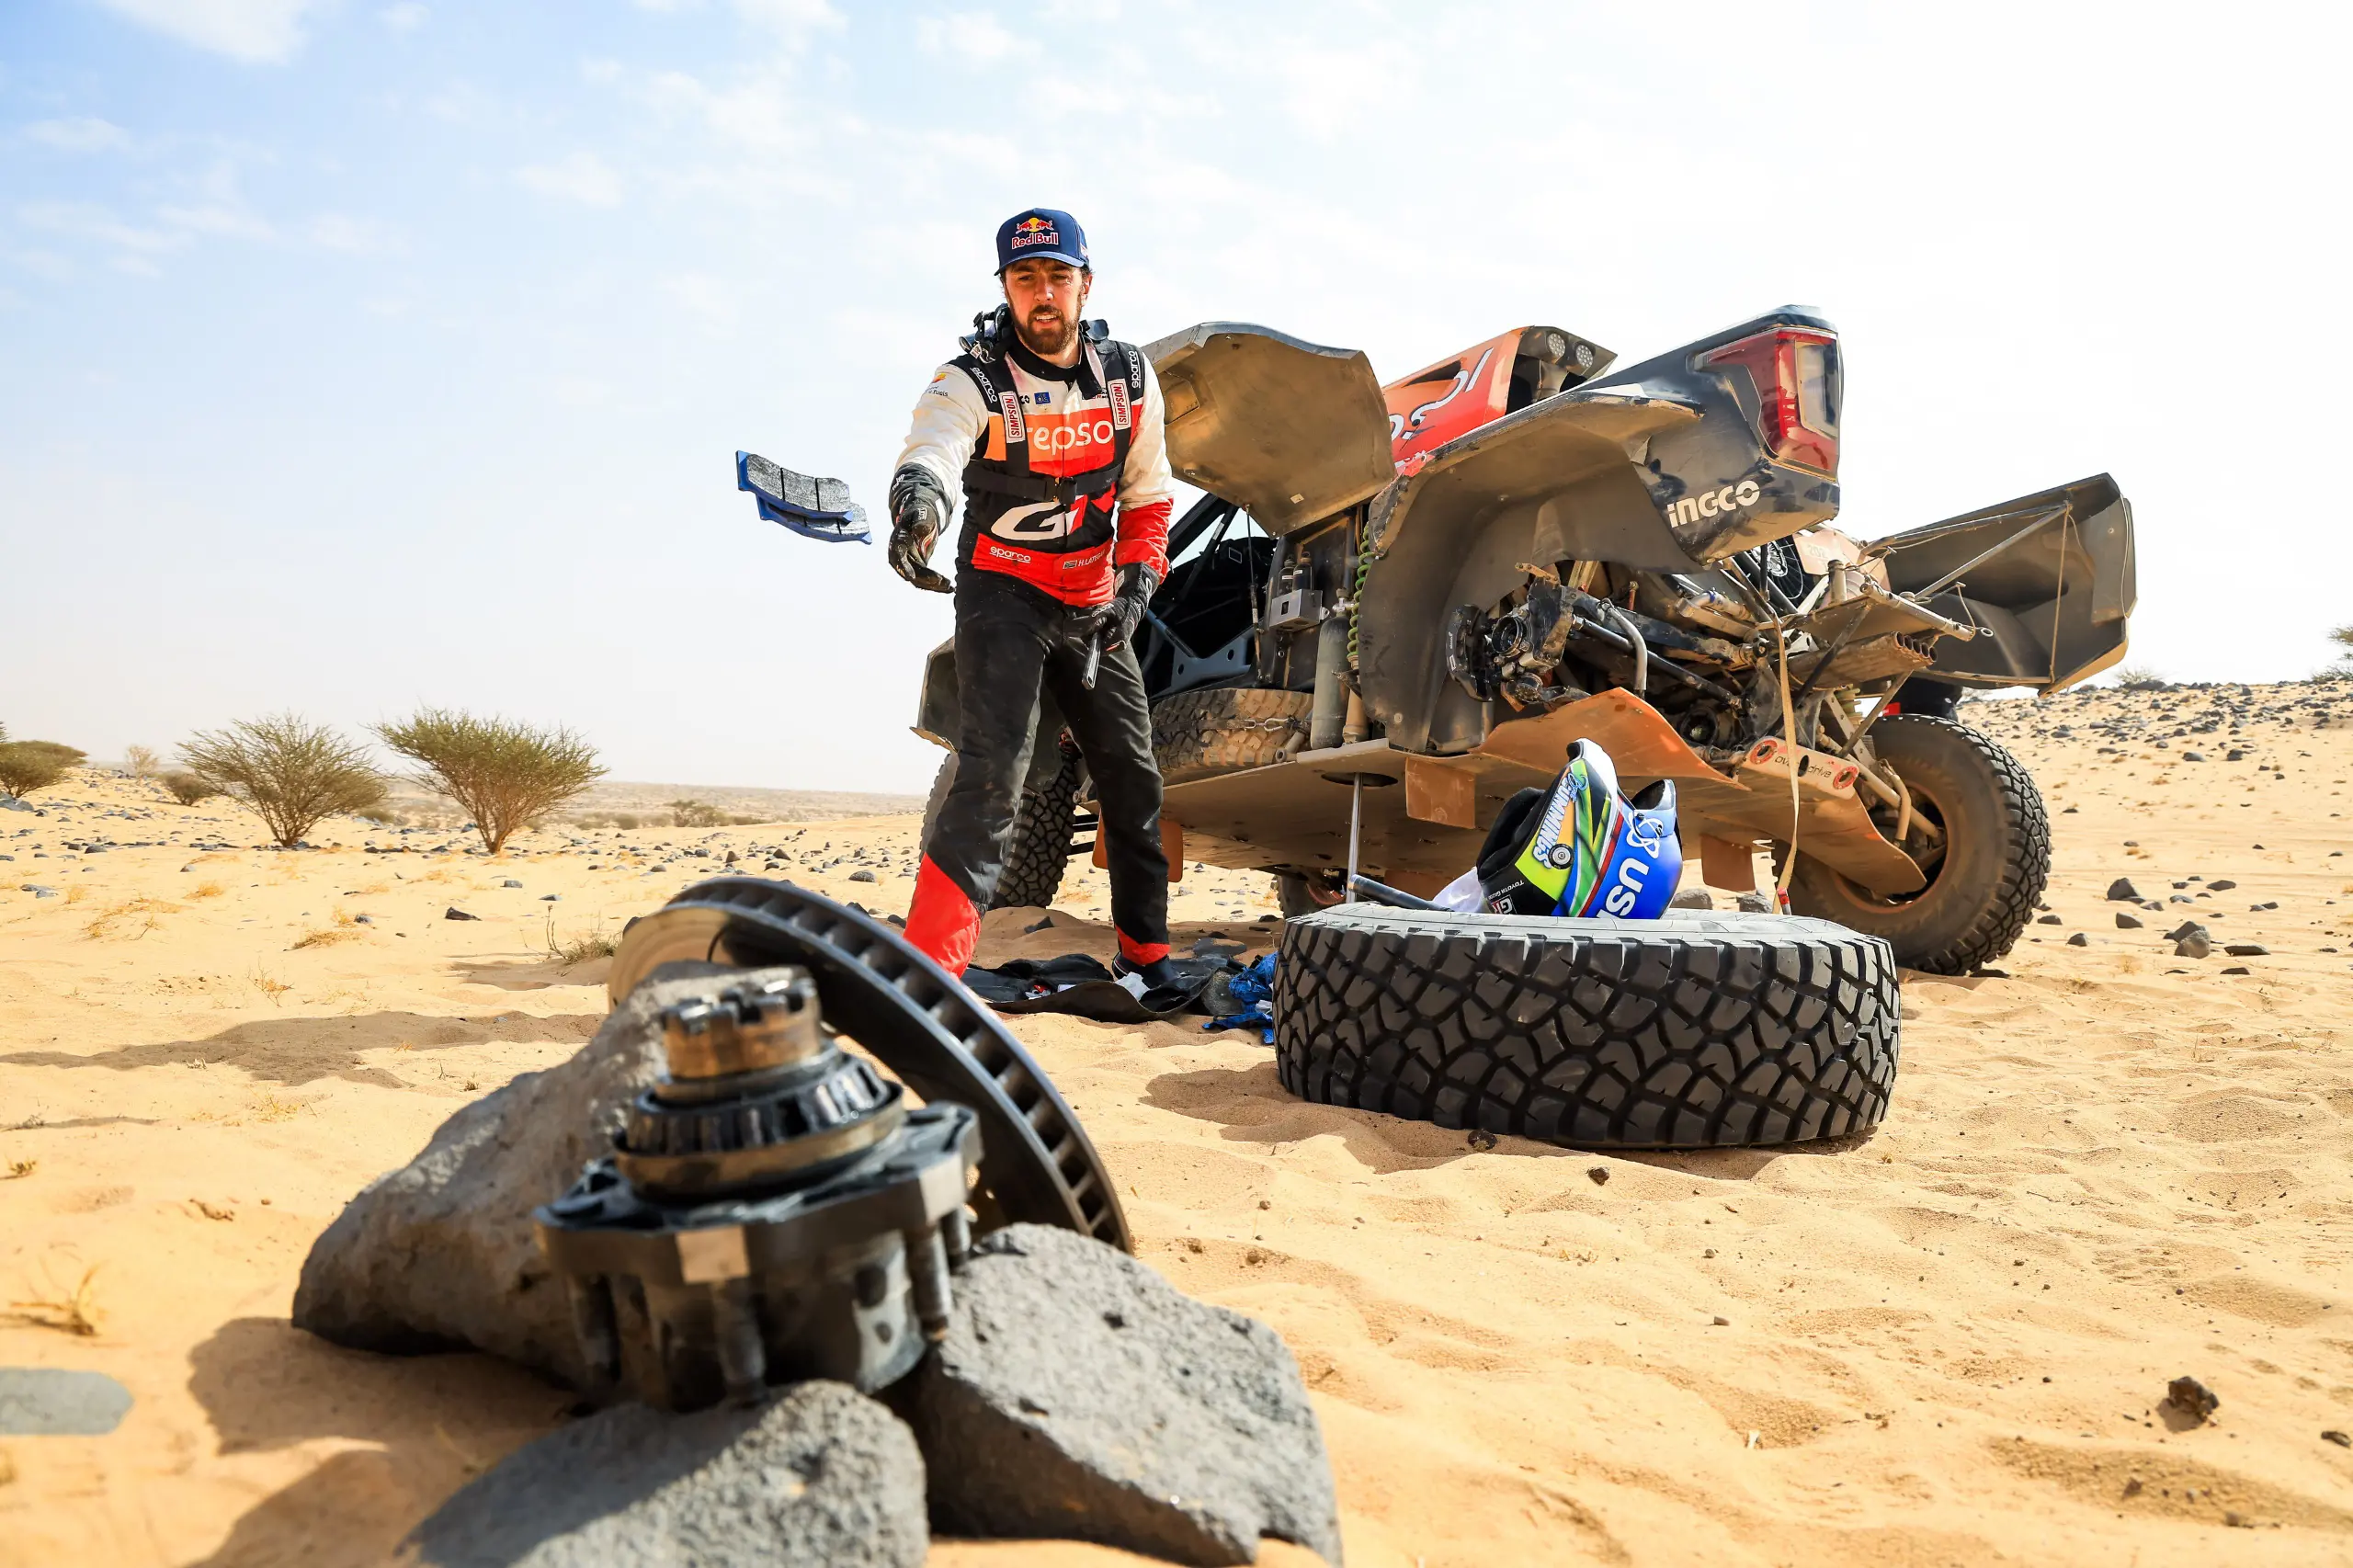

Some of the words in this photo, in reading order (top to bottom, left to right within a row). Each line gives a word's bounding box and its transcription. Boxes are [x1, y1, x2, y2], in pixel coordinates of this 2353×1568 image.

[1012, 233, 1034, 249] Red
[1035, 233, 1059, 245] Bull
[970, 367, 998, 403] sparco
[1129, 350, 1142, 389] sparco
[1006, 398, 1021, 437] SIMPSON
[1113, 386, 1128, 424] SIMPSON
[989, 546, 1031, 564] sparco
[1501, 880, 1525, 894] TOYOTA
[1597, 858, 1651, 919] US
